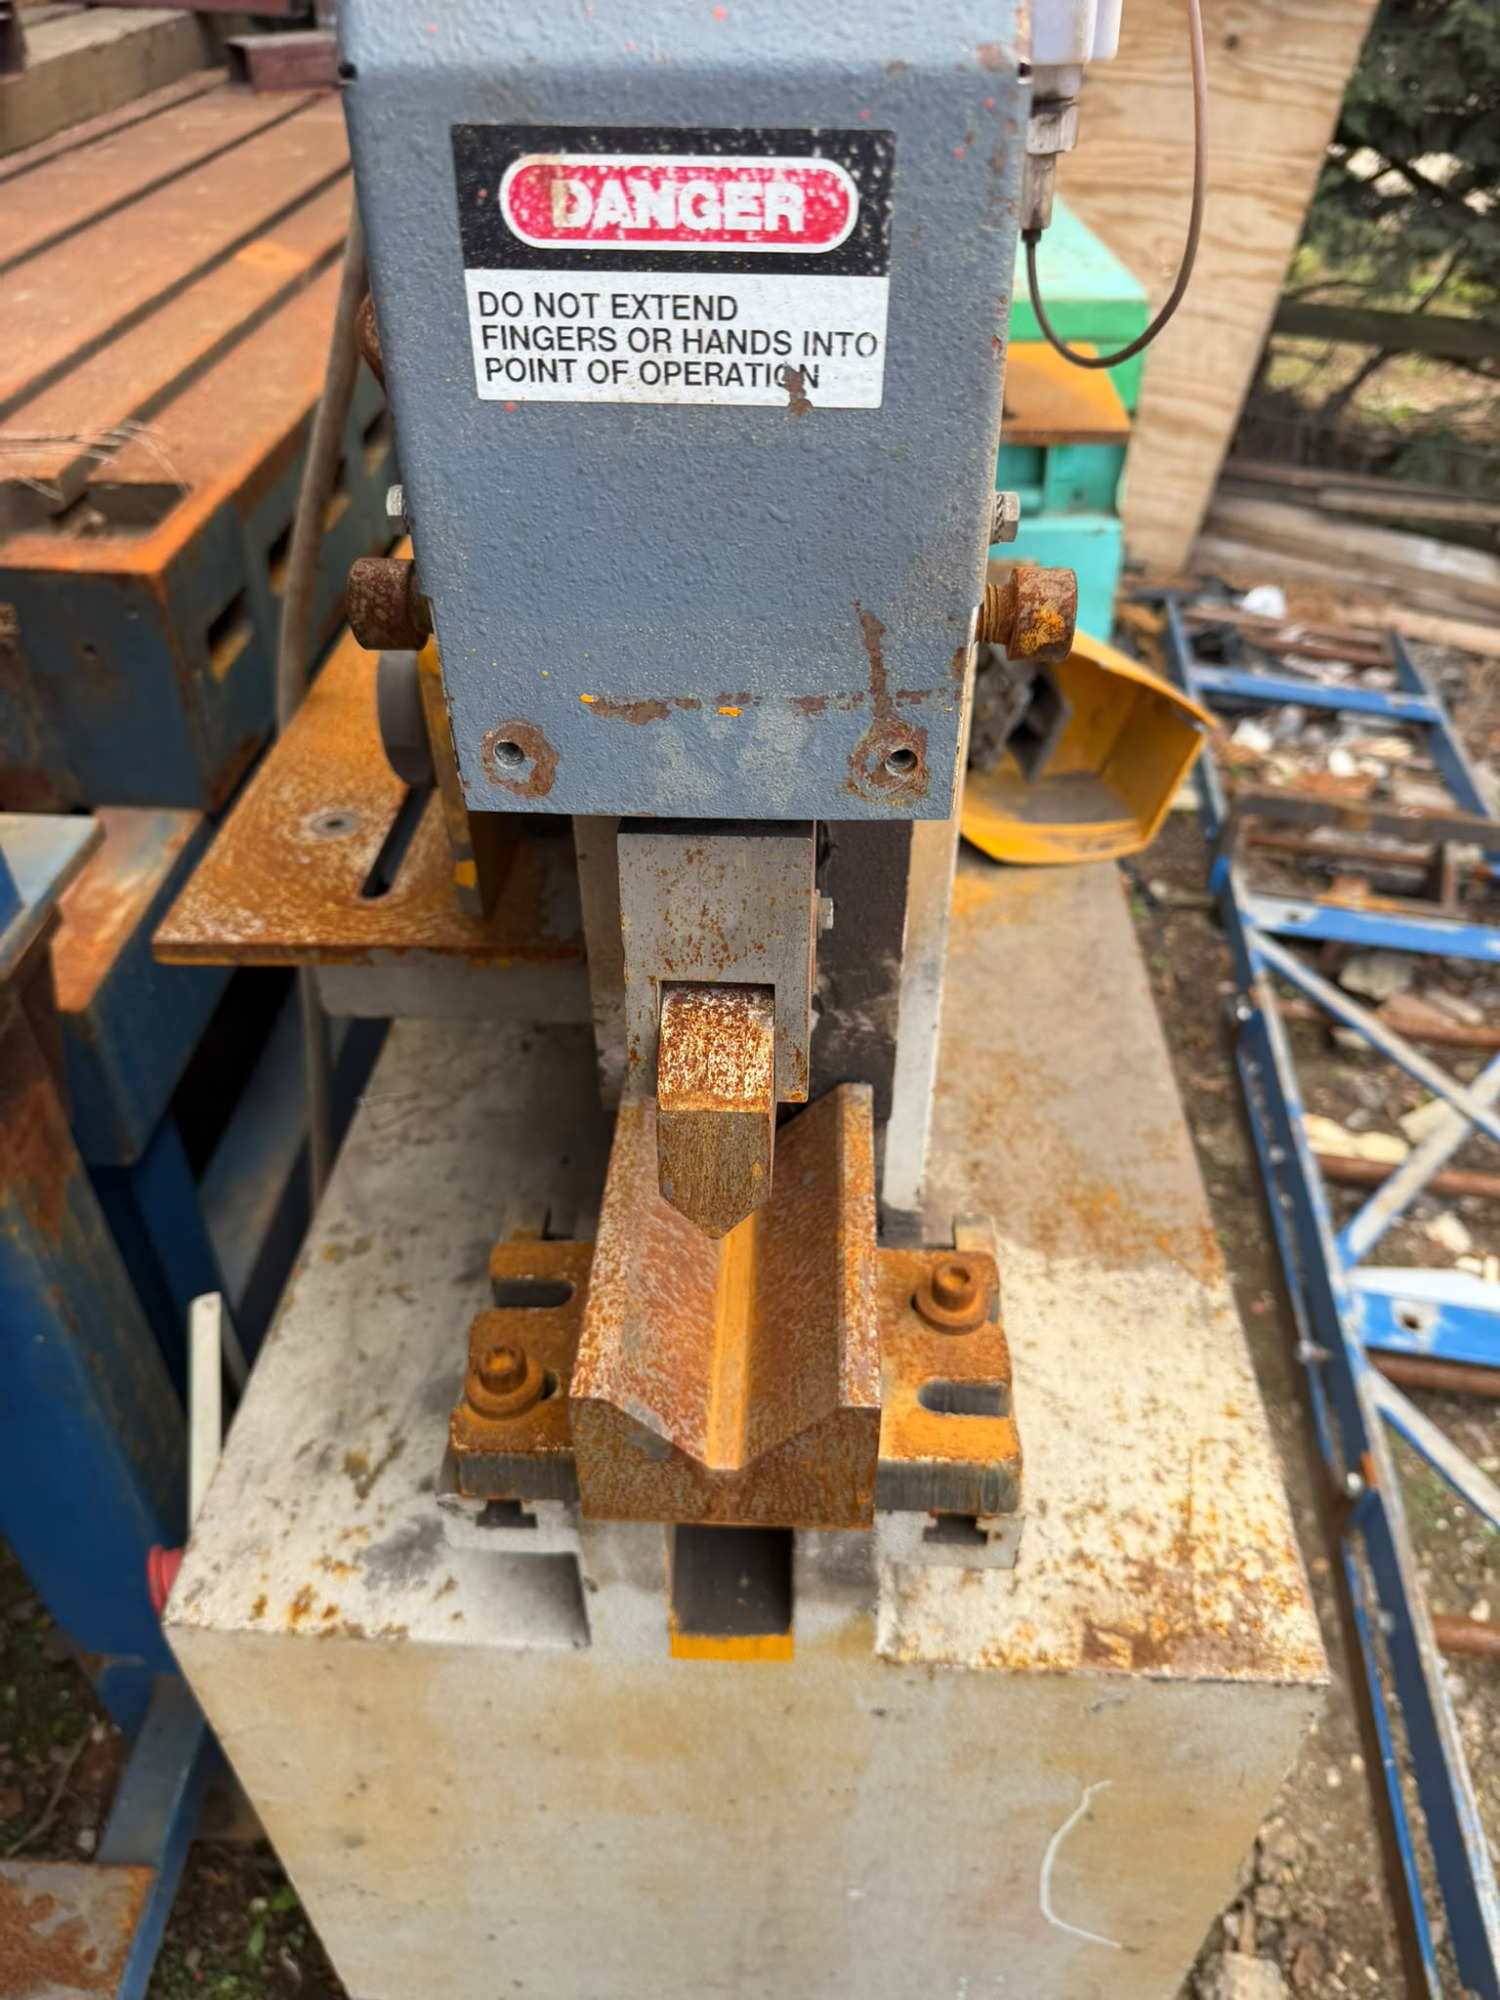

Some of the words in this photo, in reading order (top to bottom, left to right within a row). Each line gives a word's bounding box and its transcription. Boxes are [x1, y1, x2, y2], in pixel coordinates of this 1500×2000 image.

[551, 179, 804, 231] DANGER
[478, 291, 523, 317] DO
[534, 292, 600, 318] NOT
[612, 294, 738, 321] EXTEND
[481, 325, 617, 351] FINGERS
[627, 327, 672, 353] OR
[682, 328, 792, 355] HANDS
[803, 331, 878, 357] INTO
[486, 357, 577, 383] POINT
[587, 359, 629, 384] OF
